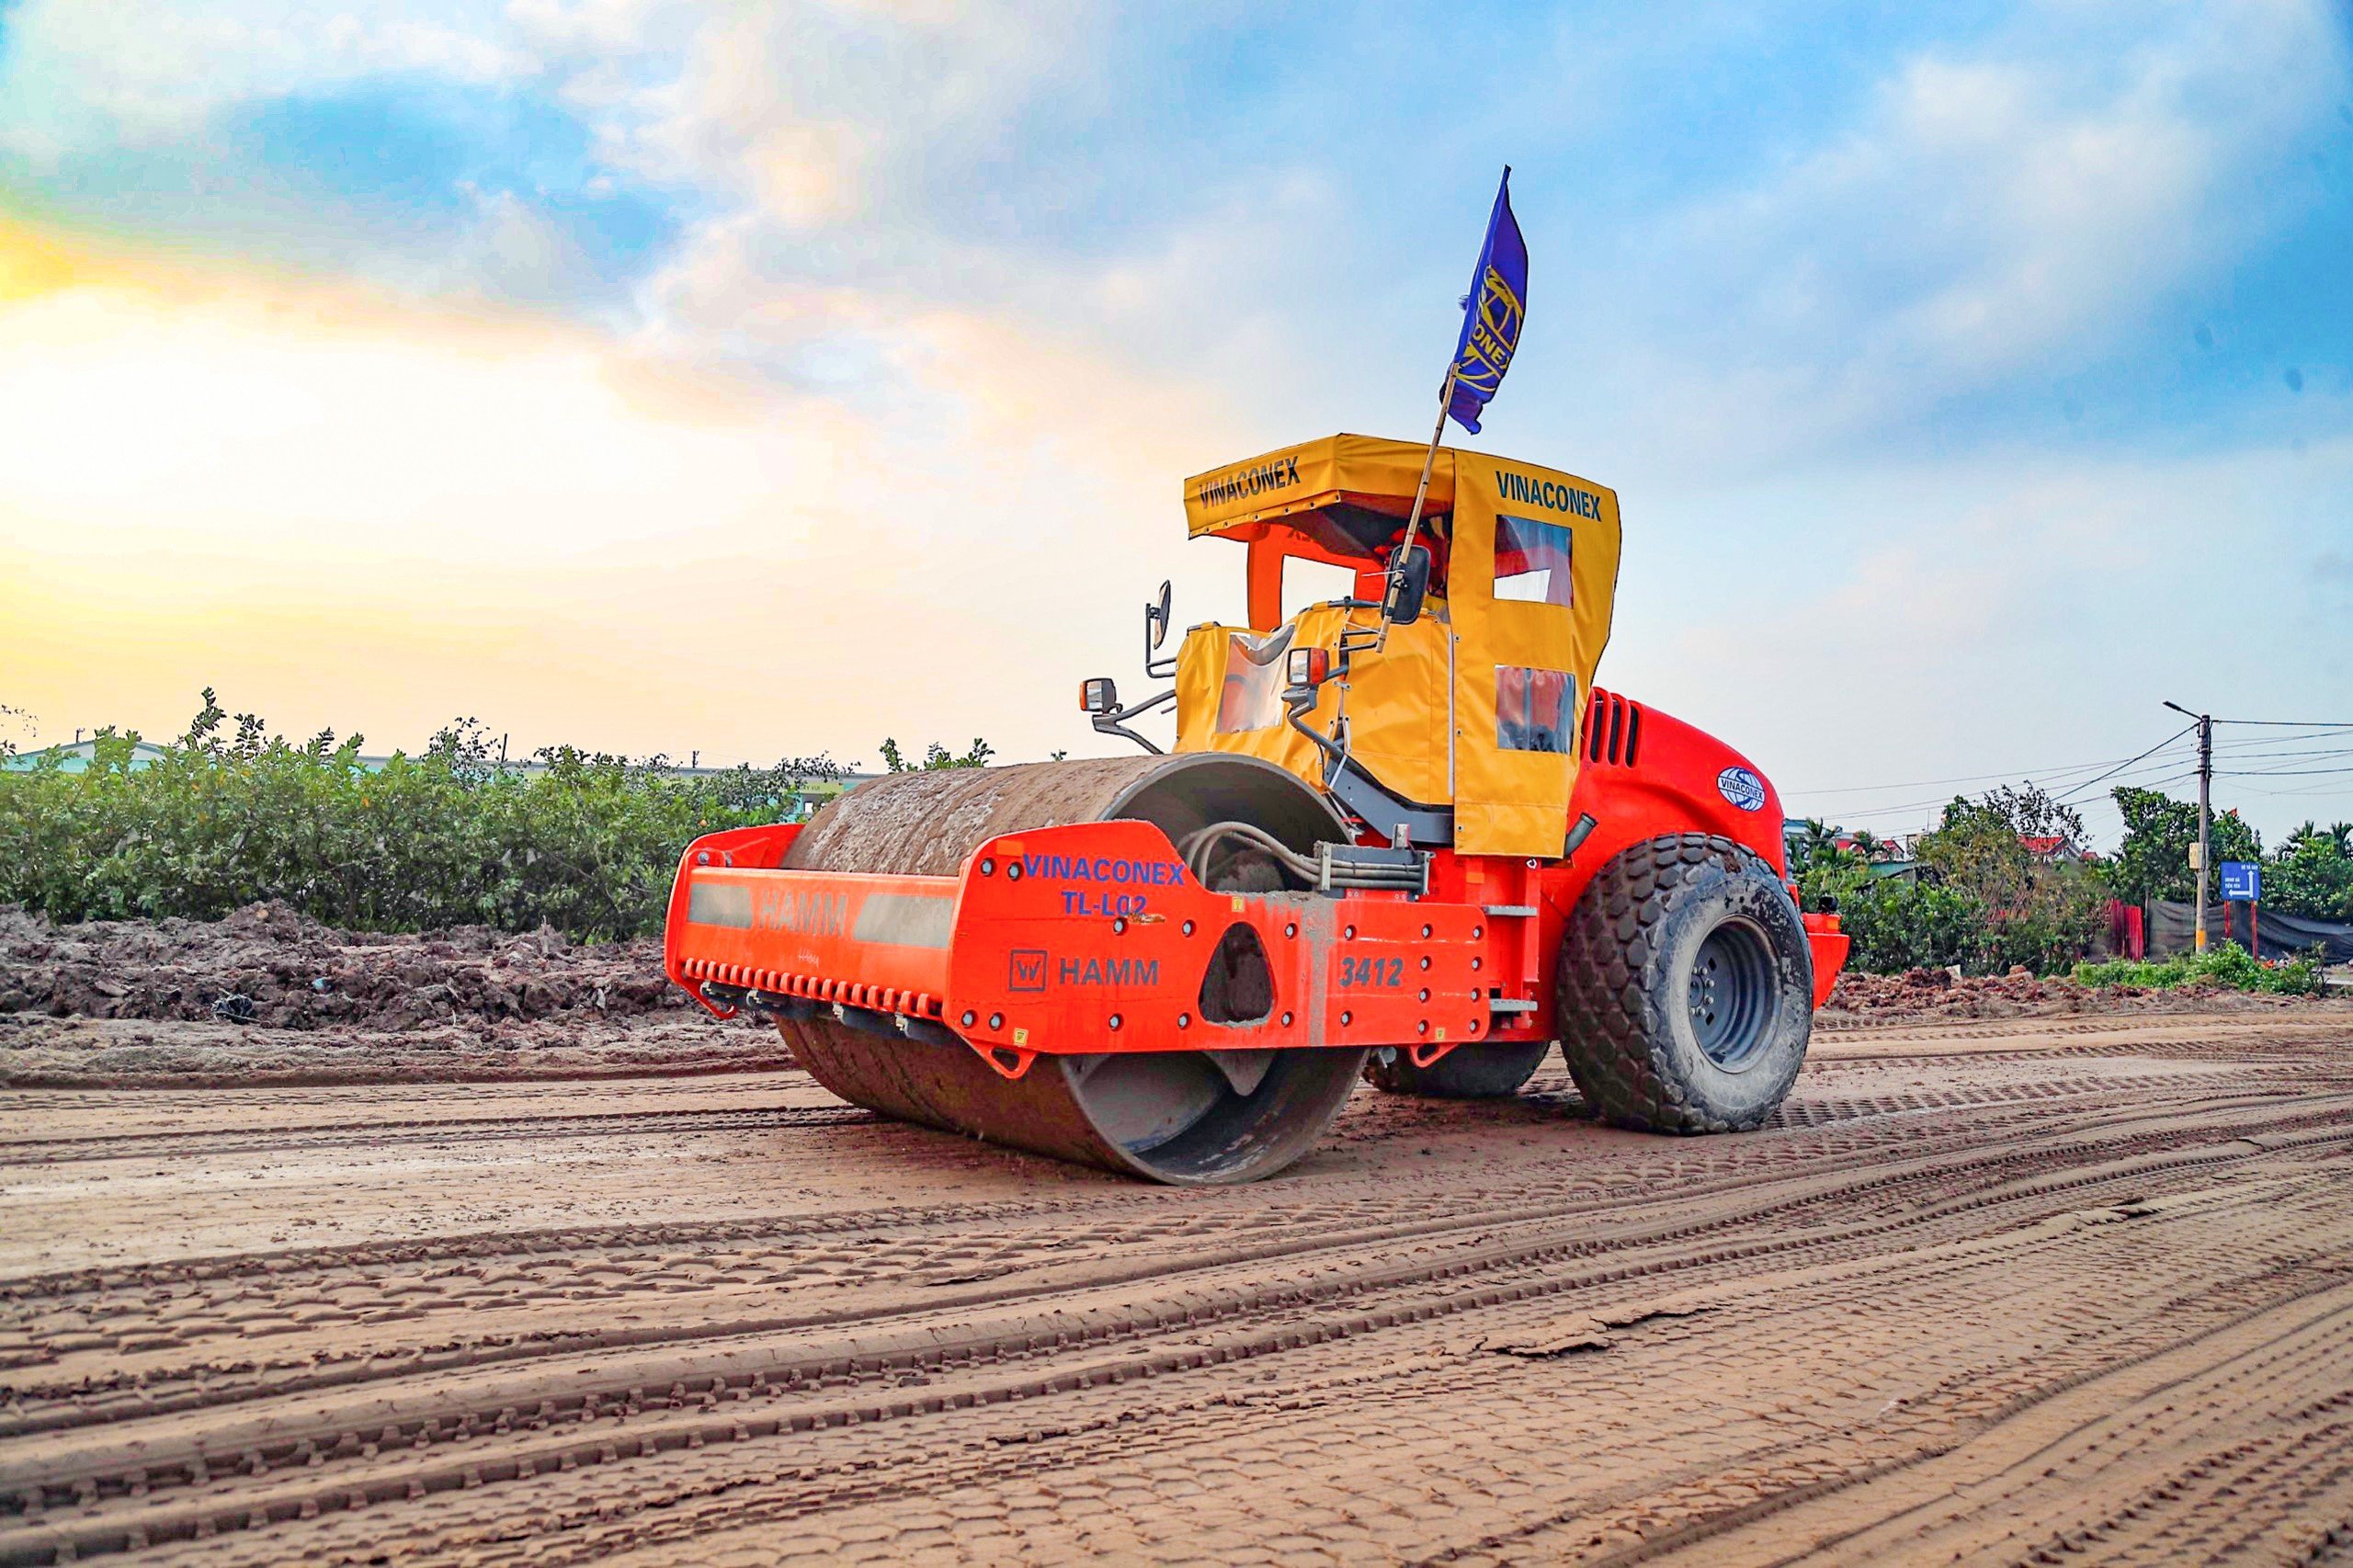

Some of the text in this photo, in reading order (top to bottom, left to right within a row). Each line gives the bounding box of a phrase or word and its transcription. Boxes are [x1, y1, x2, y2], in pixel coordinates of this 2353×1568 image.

[1199, 456, 1301, 509] VINACONEX
[1495, 471, 1601, 522] VINACONEX
[1721, 778, 1763, 801] VINACONEX
[1023, 853, 1185, 886] VINACONEX
[760, 890, 847, 937] HAMM
[1062, 891, 1147, 916] TL-L02
[1059, 958, 1159, 986] HAMM
[1339, 957, 1404, 987] 3412
